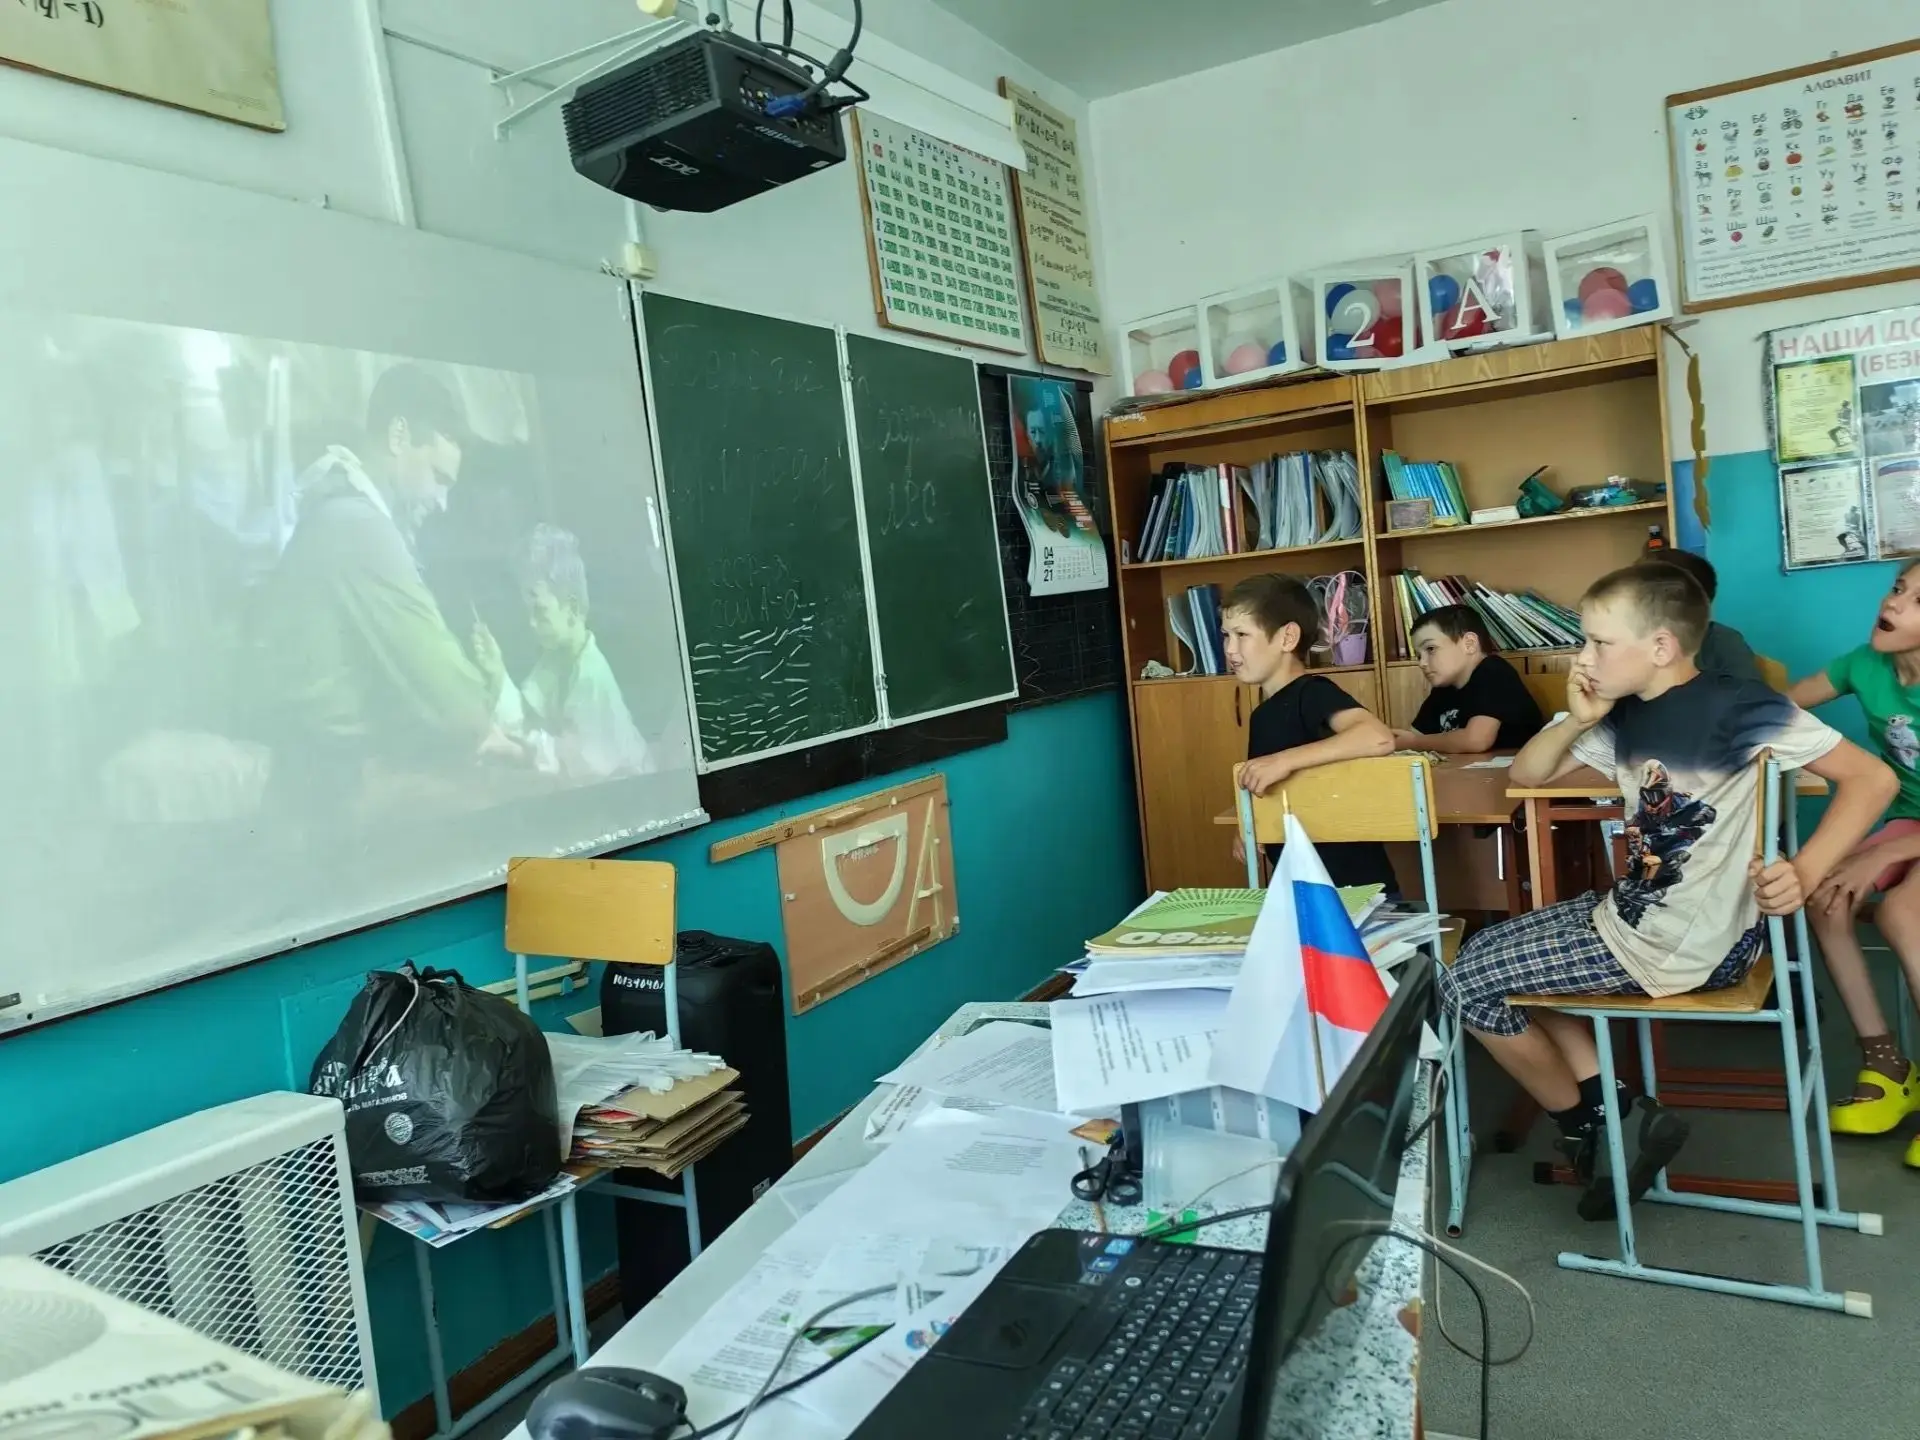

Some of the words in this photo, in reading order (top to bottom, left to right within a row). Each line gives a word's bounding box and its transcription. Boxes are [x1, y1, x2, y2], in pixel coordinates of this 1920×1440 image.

[1803, 69, 1872, 95] АЛФАВИТ
[648, 156, 700, 176] acer
[1343, 301, 1376, 349] 2
[1450, 277, 1503, 330] А
[1779, 324, 1876, 359] НАШИ
[1043, 546, 1055, 560] 04
[1043, 568, 1054, 582] 21
[361, 1092, 408, 1109] МАГАЗИНОВ
